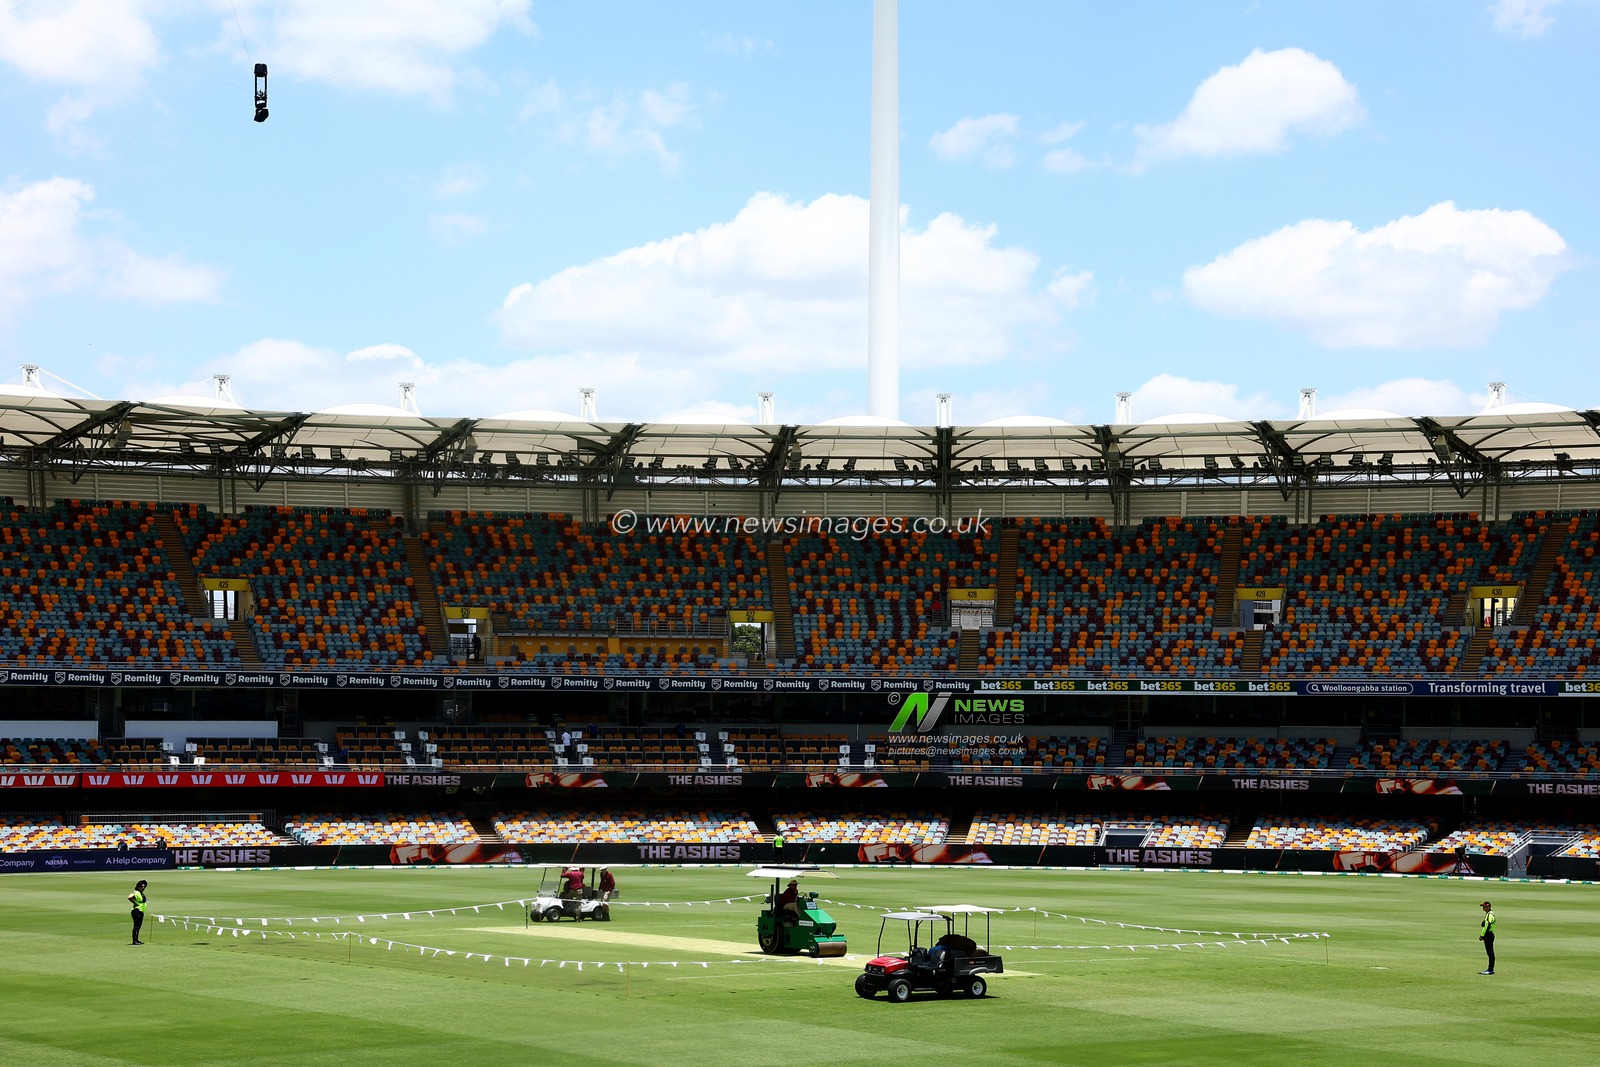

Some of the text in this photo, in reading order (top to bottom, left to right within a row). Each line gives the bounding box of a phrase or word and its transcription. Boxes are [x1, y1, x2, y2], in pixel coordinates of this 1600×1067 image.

[11, 672, 48, 682] Remitly
[68, 673, 104, 683] Remitly
[125, 674, 161, 684] Remitly
[183, 674, 219, 684] Remitly
[238, 675, 274, 685] Remitly
[293, 675, 328, 686] Remitly
[350, 676, 384, 686] Remitly
[403, 676, 438, 687] Remitly
[456, 677, 491, 687] Remitly
[511, 677, 545, 688] Remitly
[564, 678, 597, 688] Remitly
[616, 678, 650, 689] Remitly
[672, 679, 705, 689] Remitly
[724, 679, 757, 690] Remitly
[776, 680, 810, 690] Remitly
[831, 680, 865, 690] Remitly
[884, 680, 917, 691] Remitly
[936, 681, 970, 691] Remitly
[981, 681, 1022, 690] bet365
[1034, 681, 1075, 690] bet365
[1088, 681, 1128, 690] bet365
[1140, 681, 1181, 690] bet365
[1194, 682, 1235, 691] bet365
[1249, 682, 1290, 691] bet365
[1565, 682, 1600, 692] bet36
[1322, 684, 1379, 693] Woolloongabba
[1428, 682, 1546, 695] Transforming travel
[385, 775, 461, 785] THE ASHES
[668, 775, 742, 785] THE ASHES
[948, 776, 1023, 786] THE ASHES
[1232, 779, 1309, 790] THE ASHES
[1527, 784, 1553, 794] THE
[172, 850, 270, 864] HE ASHES
[637, 846, 740, 859] THE ASHES
[1105, 849, 1212, 864] THE ASHES
[0, 860, 35, 868] Company
